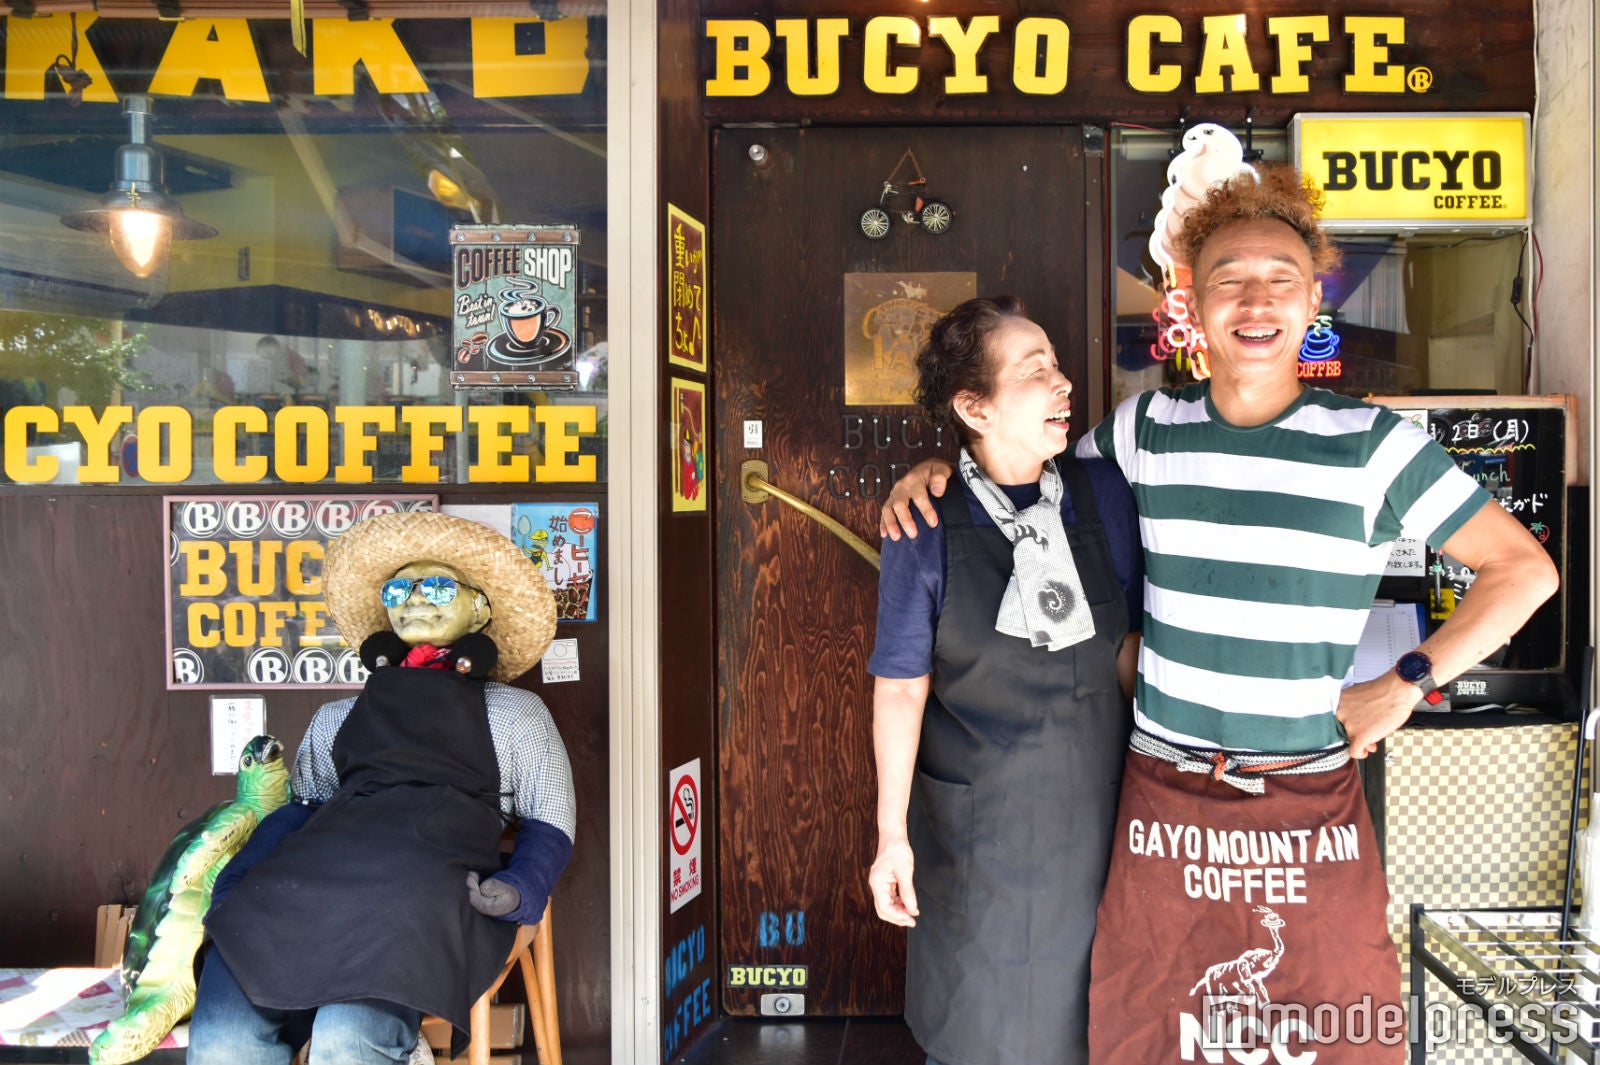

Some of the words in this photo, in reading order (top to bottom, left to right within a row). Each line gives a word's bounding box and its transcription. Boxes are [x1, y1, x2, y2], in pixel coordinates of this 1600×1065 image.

[706, 16, 1070, 97] BUCYO
[1127, 14, 1405, 94] CAFE
[1323, 151, 1501, 191] BUCYO
[457, 248, 521, 290] COFFEE
[524, 248, 572, 289] SHOP
[458, 295, 482, 315] Best
[1296, 361, 1342, 378] COFFEE
[212, 406, 597, 483] COFFEE
[179, 540, 335, 596] BUC
[187, 601, 348, 648] COFF
[1129, 819, 1202, 861] GAYO
[1207, 824, 1360, 866] MOUNTAIN
[1184, 864, 1308, 904] COFFEE
[731, 967, 806, 986] BUCYO
